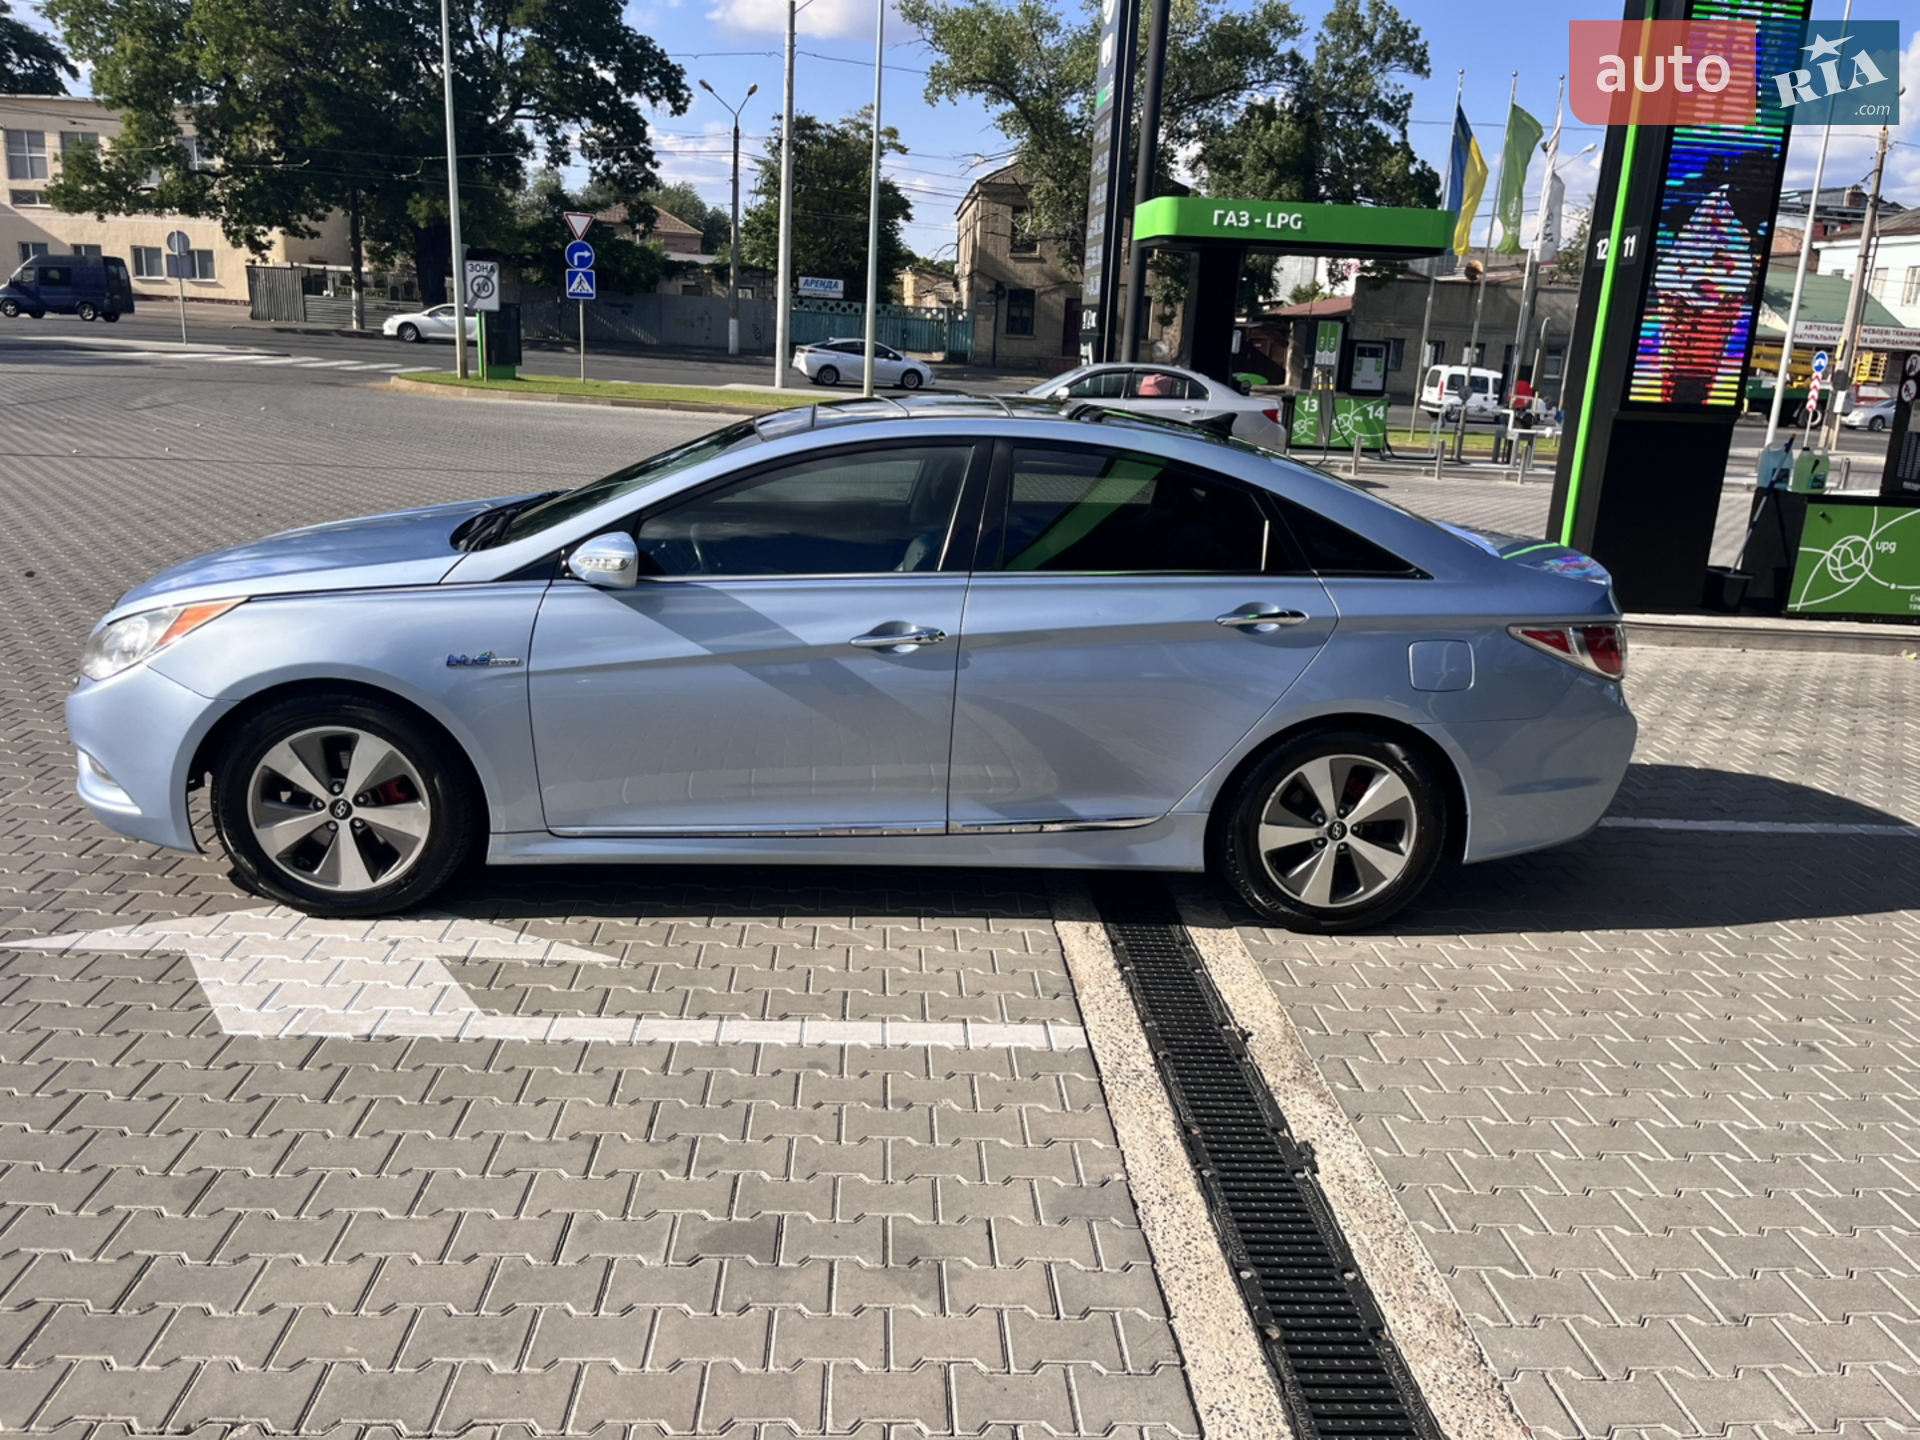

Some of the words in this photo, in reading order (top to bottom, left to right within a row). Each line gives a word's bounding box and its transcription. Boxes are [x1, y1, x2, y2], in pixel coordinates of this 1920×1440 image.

[1213, 209, 1250, 228] ГАЗ
[1266, 212, 1302, 231] LPG
[1596, 238, 1609, 260] 12
[1623, 235, 1636, 258] 11
[469, 263, 496, 274] ЗОНА
[803, 278, 839, 290] АРЕНДА
[1302, 398, 1318, 413] 13
[1366, 405, 1385, 420] 14
[1875, 541, 1897, 554] upg
